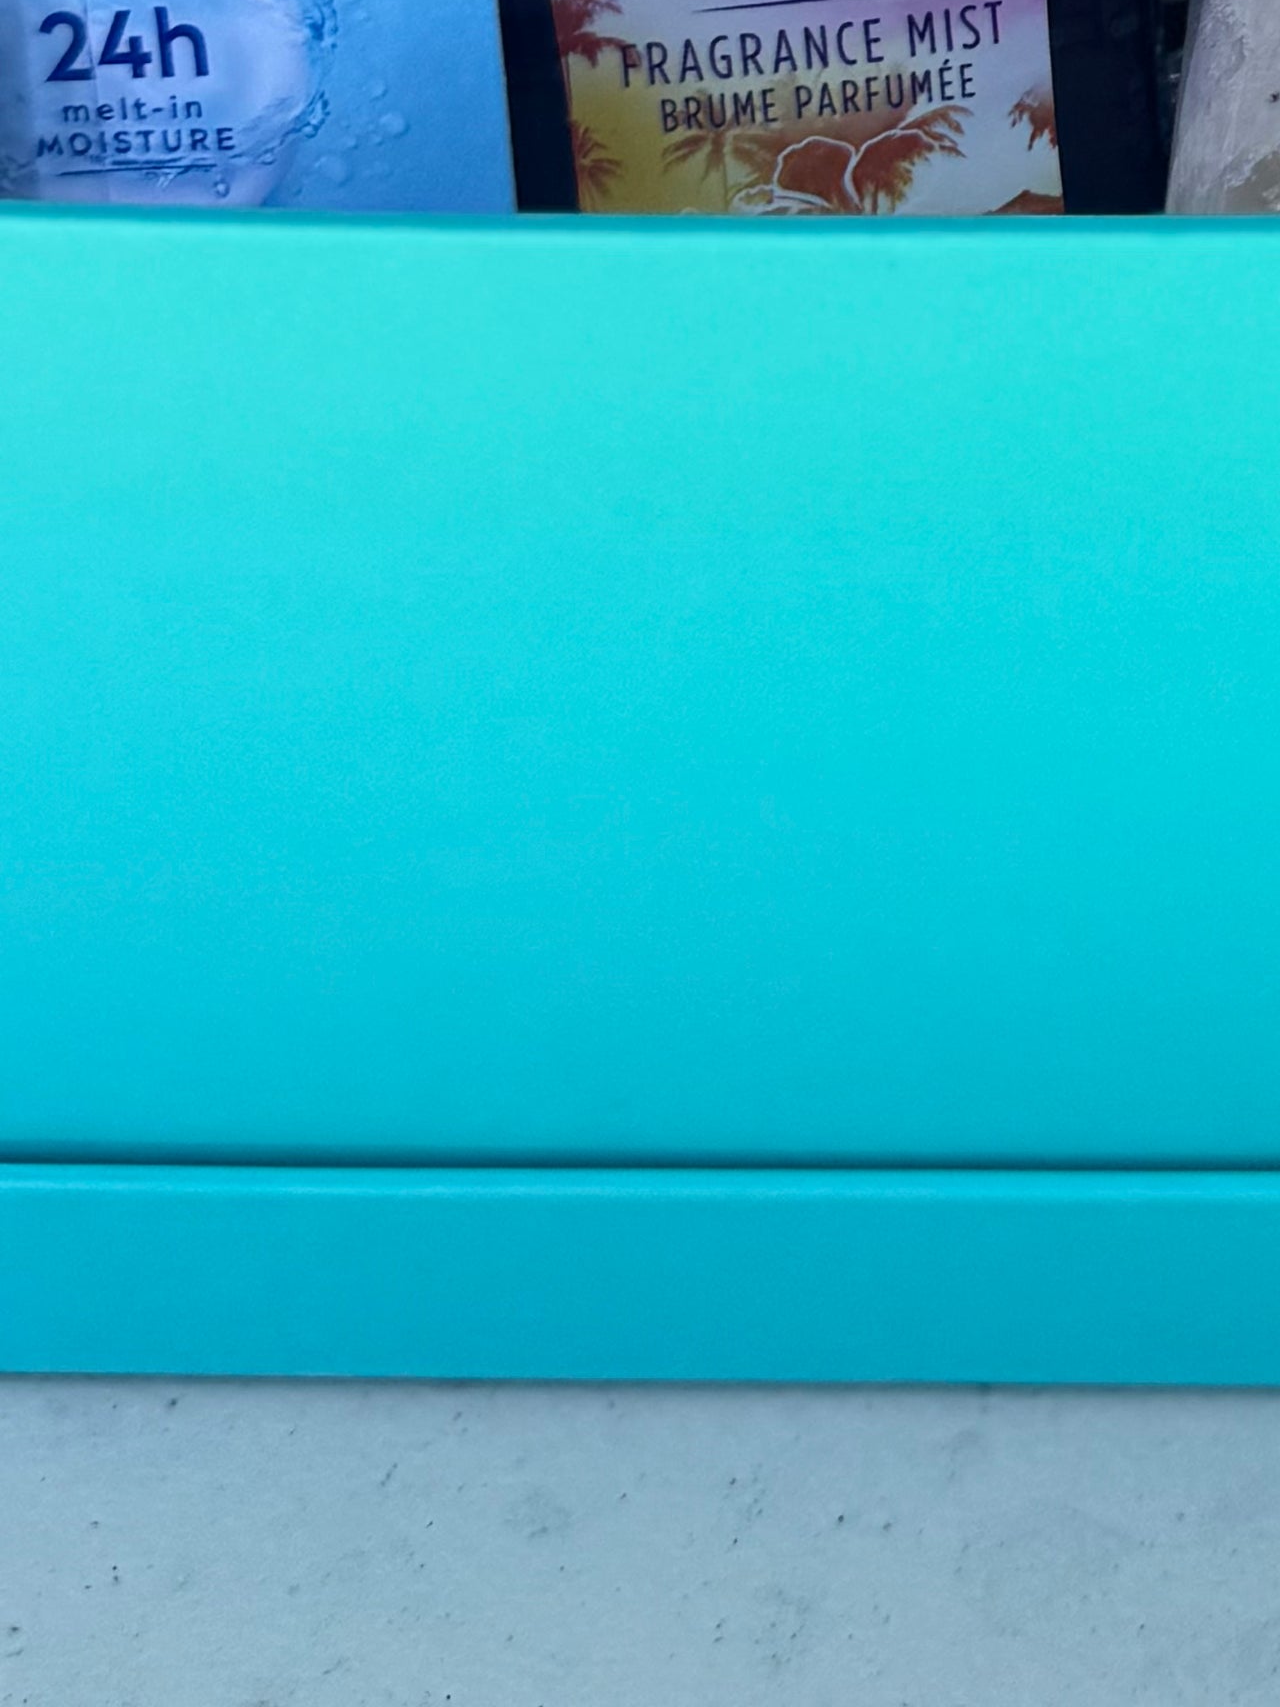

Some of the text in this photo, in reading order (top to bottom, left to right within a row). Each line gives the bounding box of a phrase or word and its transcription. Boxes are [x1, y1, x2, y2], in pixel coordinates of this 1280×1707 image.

[38, 4, 211, 83] 24h
[620, 0, 1004, 90] FRAGRANCE MIST
[62, 97, 204, 122] melt-in
[660, 59, 977, 136] BRUME PARFUMÉE
[37, 125, 238, 160] MOISTURE
